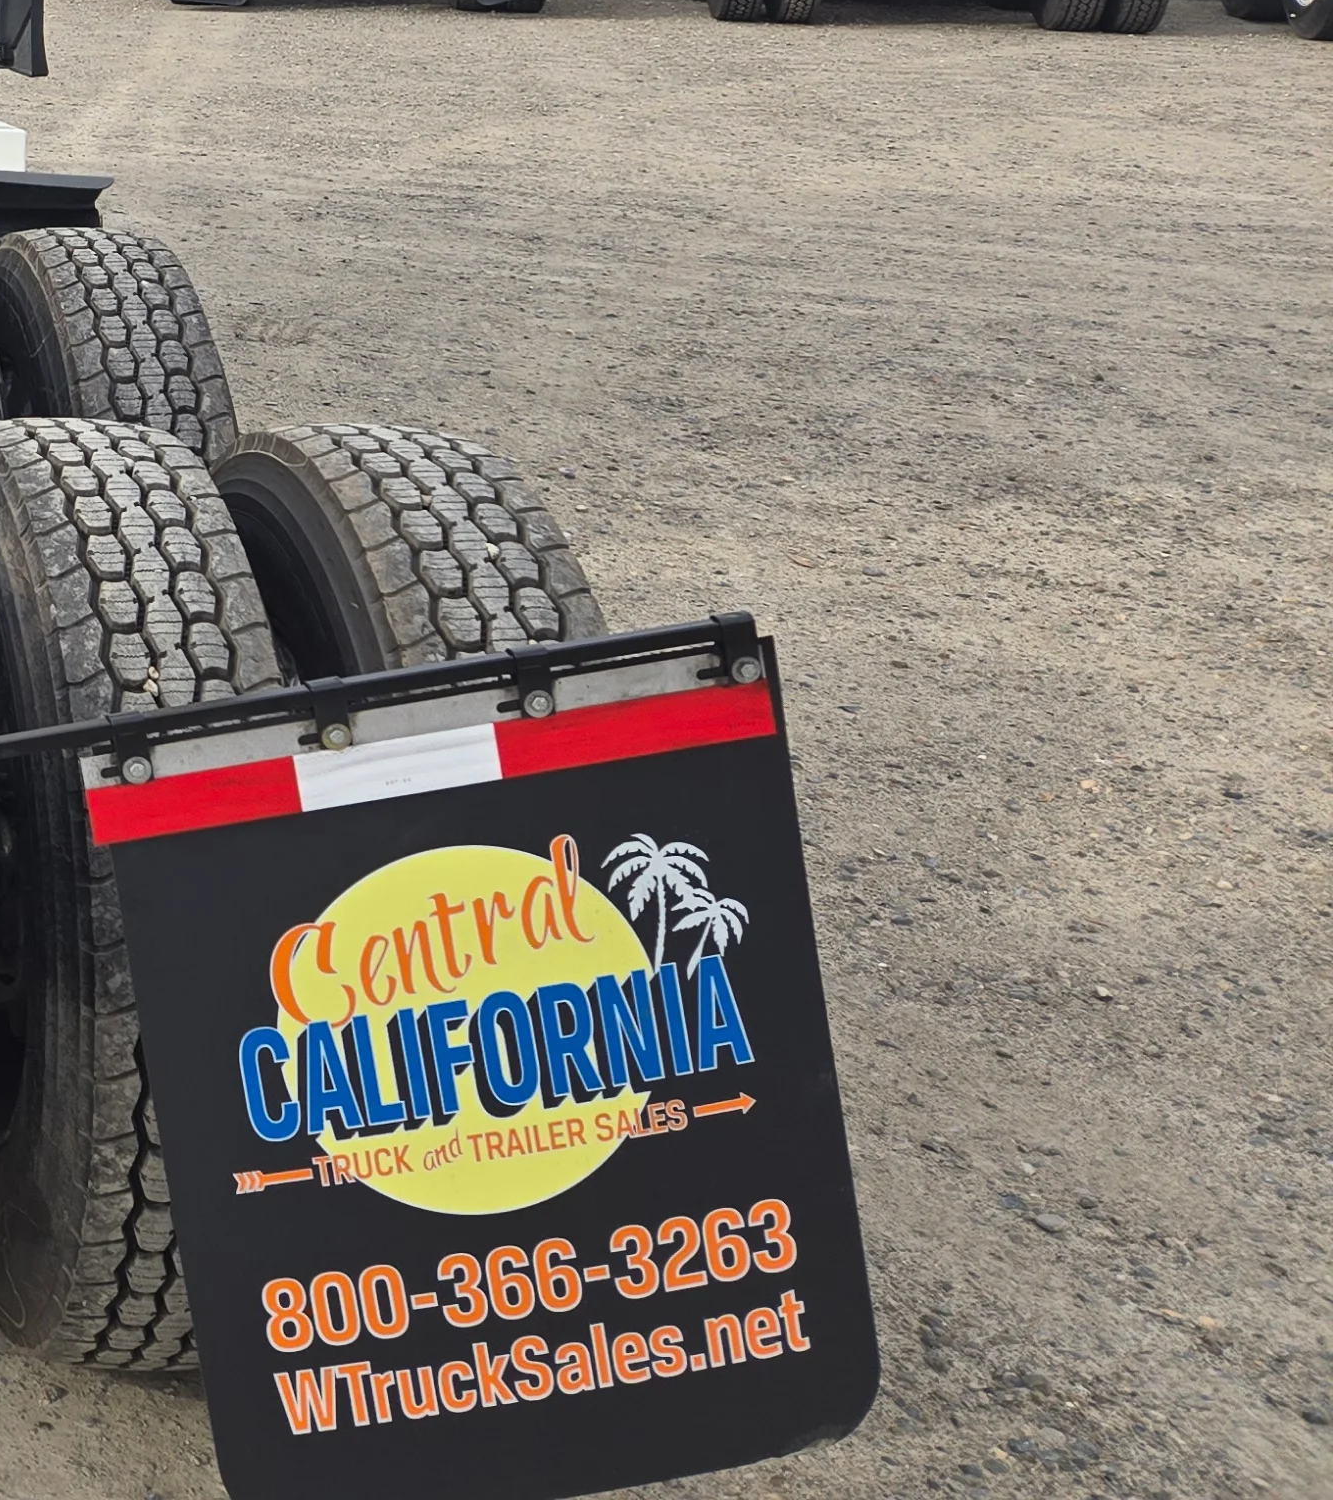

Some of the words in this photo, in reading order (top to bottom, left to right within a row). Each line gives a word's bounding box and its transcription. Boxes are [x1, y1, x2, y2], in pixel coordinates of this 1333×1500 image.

[269, 833, 596, 1030] Central
[237, 953, 756, 1144] CALIFORNIA
[312, 1145, 414, 1189] TRUCK
[422, 1127, 464, 1172] and
[469, 1121, 589, 1165] TRAILER
[593, 1098, 689, 1144] SALES
[260, 1197, 799, 1355] 800-366-3263
[273, 1288, 812, 1438] WTruckSales.net
